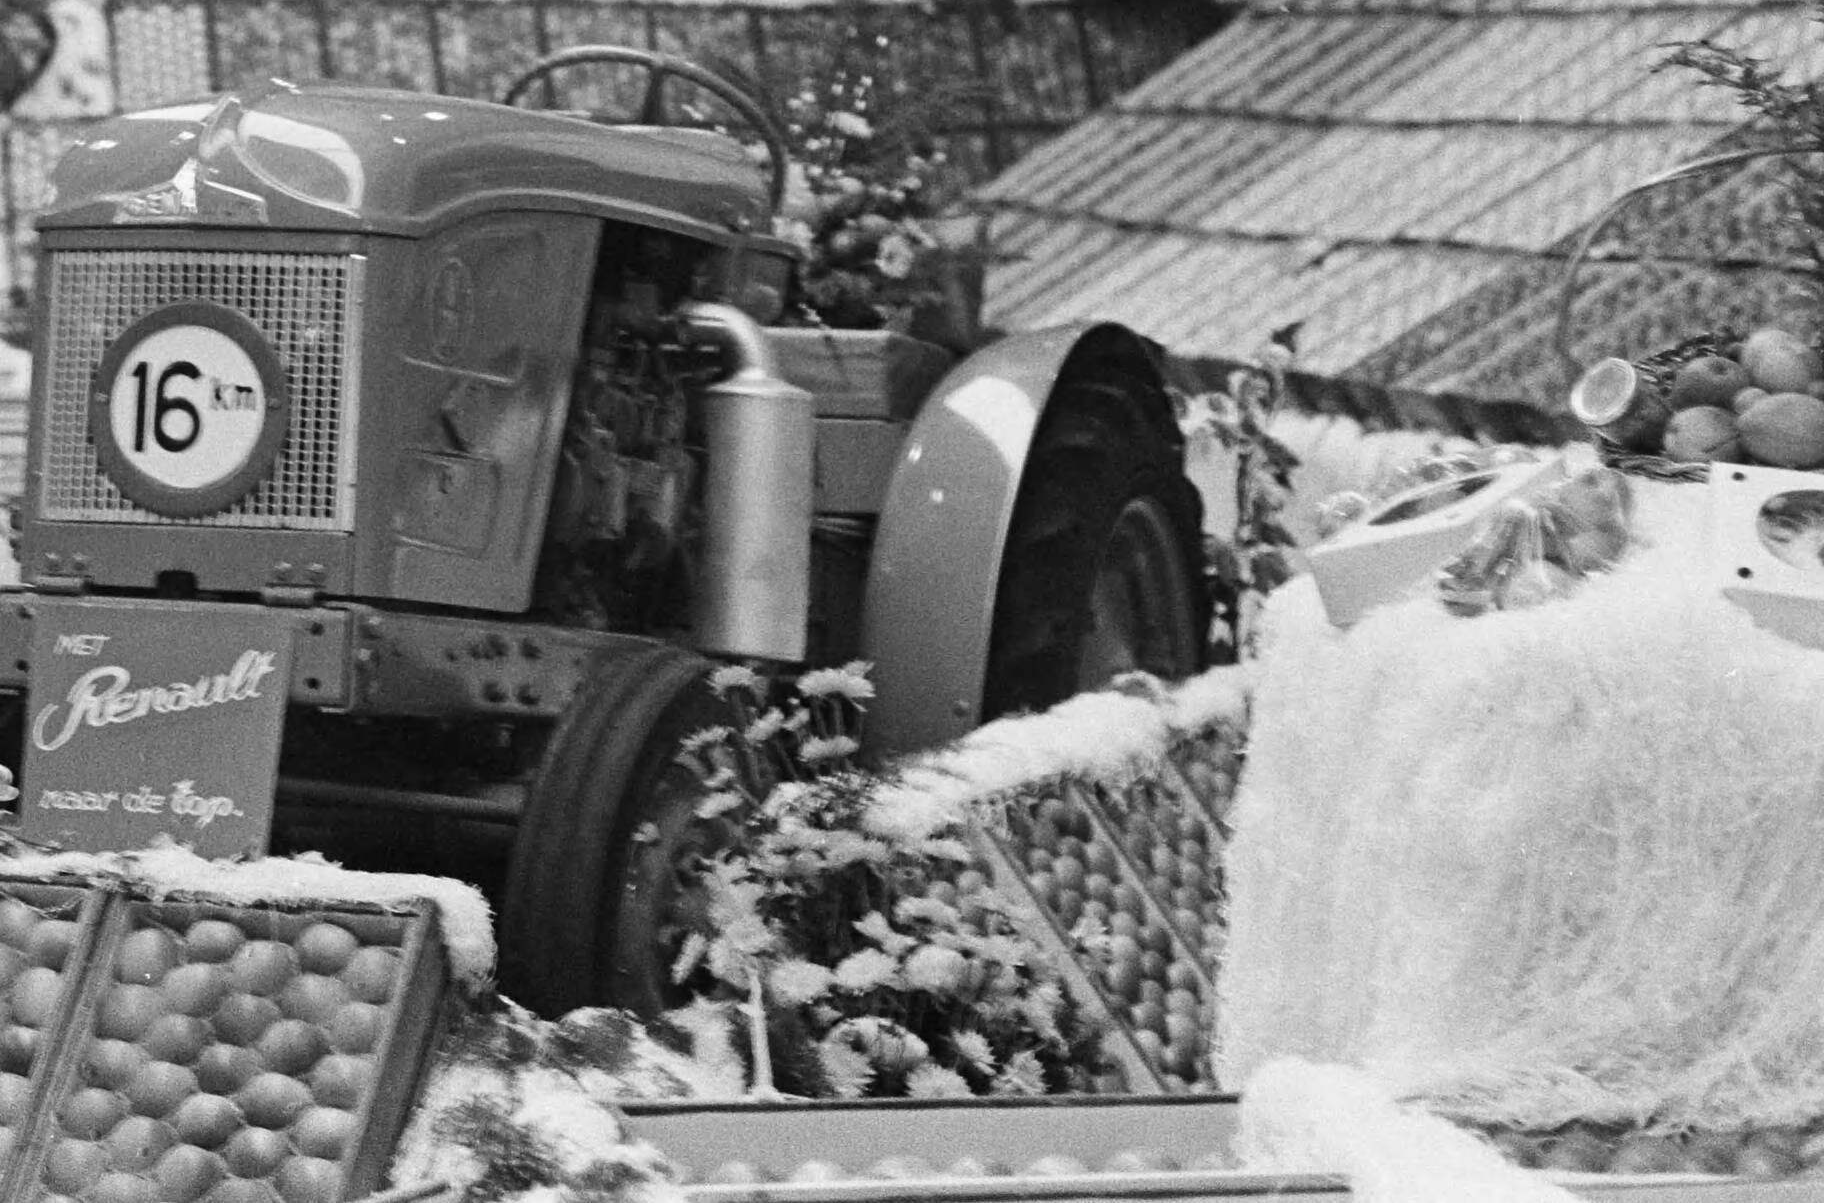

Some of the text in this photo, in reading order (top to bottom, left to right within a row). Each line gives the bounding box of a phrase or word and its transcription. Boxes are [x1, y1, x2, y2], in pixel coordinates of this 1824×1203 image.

[132, 360, 202, 454] 16
[32, 649, 277, 751] Renault
[37, 790, 120, 812] naar
[121, 785, 167, 814] de
